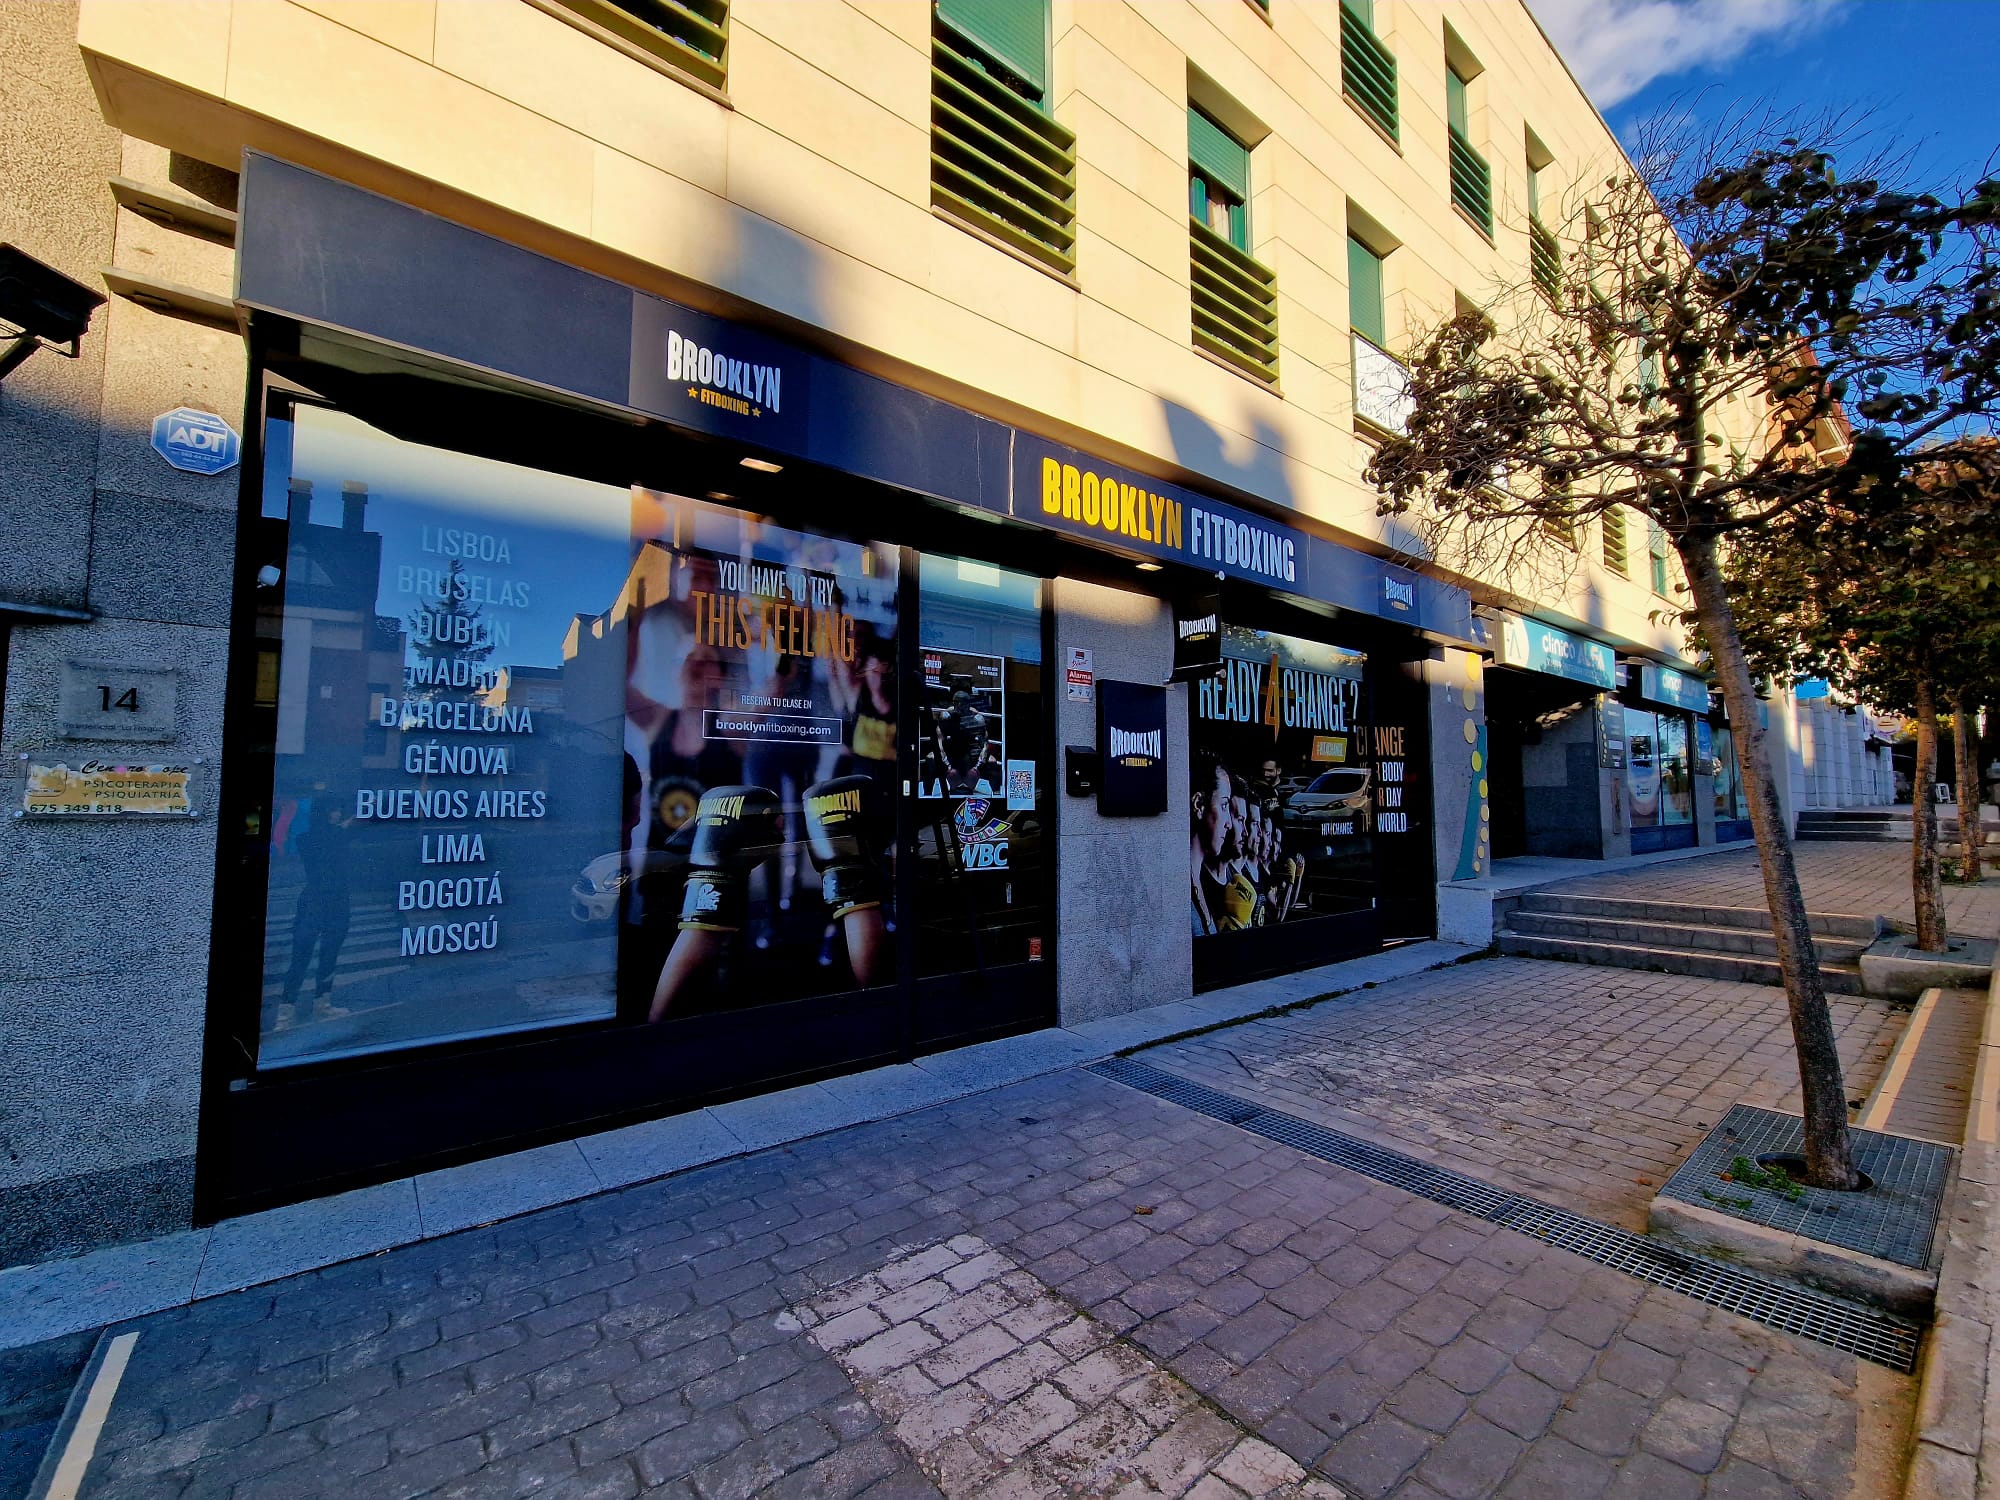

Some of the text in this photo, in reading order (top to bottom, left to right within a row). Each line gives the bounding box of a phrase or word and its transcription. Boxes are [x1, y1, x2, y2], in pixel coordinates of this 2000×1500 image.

[667, 329, 780, 414] BROOKLYN
[700, 388, 749, 416] FITBOXING
[168, 426, 226, 453] ADT
[1042, 457, 1295, 582] BROOKLYN FITBOXING
[422, 525, 512, 565] LISBOA
[398, 564, 531, 608] BRUSELAS
[718, 559, 835, 607] YOU HAVE TO TRY
[1385, 576, 1413, 607] BROOKLYN
[416, 611, 511, 647] DUBLÍN
[691, 590, 855, 662] THIS FEELING
[1179, 614, 1216, 639] BROOKLYN
[408, 657, 512, 689] MADRID
[1069, 671, 1091, 680] Alarma
[97, 685, 140, 712] 14
[741, 694, 812, 710] RESERVA TU CLASE EN
[1199, 658, 1262, 724] READY
[380, 697, 533, 733] BARCELONA
[716, 719, 831, 736] brooklynfitboxing.com
[405, 739, 508, 775] GÉNOVA
[1110, 725, 1161, 760] BROOKLYN
[81, 760, 145, 774] Cenro
[1382, 762, 1404, 782] BODY
[84, 780, 182, 789] PSICOTERAPIA
[95, 791, 181, 799] PSIQUIATRIA
[1386, 787, 1402, 808] DAY
[29, 804, 57, 813] 675
[63, 804, 90, 813] 349
[96, 804, 123, 813] 818
[356, 789, 547, 819] BUENOS AIRES
[1377, 812, 1407, 833] WORLD
[421, 833, 486, 864] LIMA
[962, 843, 1009, 867] WBC
[399, 871, 503, 911] BOGOTÁ
[400, 915, 498, 957] MOSCÚ
